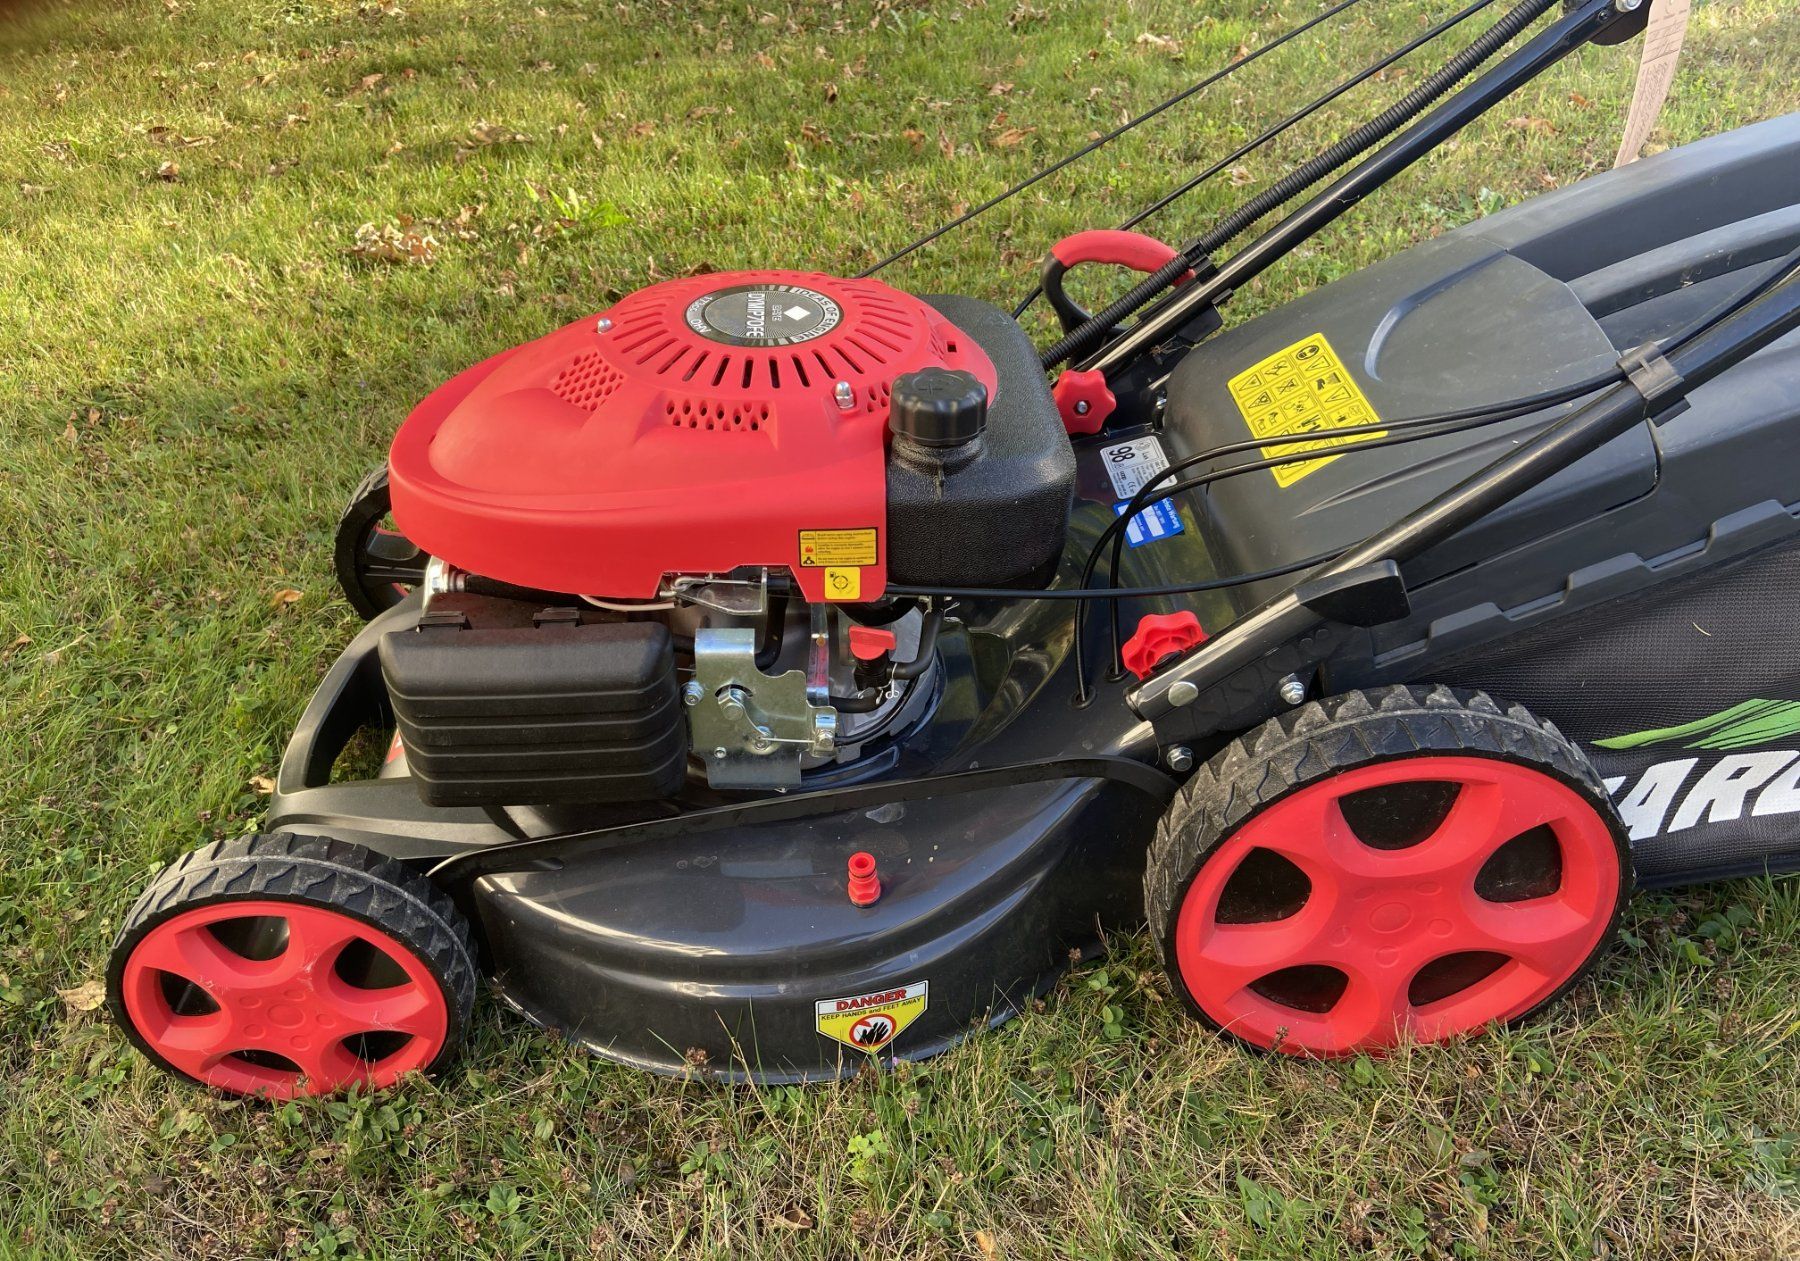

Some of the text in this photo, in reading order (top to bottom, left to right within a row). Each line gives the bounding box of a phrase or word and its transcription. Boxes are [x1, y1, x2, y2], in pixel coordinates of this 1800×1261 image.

[690, 319, 712, 333] OHV
[795, 288, 838, 343] IDEAS OF ENGINE
[1109, 446, 1135, 463] 98
[1602, 750, 1800, 842] AR
[836, 989, 907, 1011] DANGER
[842, 1009, 867, 1018] HANDS
[883, 1003, 899, 1012] FEET
[901, 997, 921, 1006] AWAY
